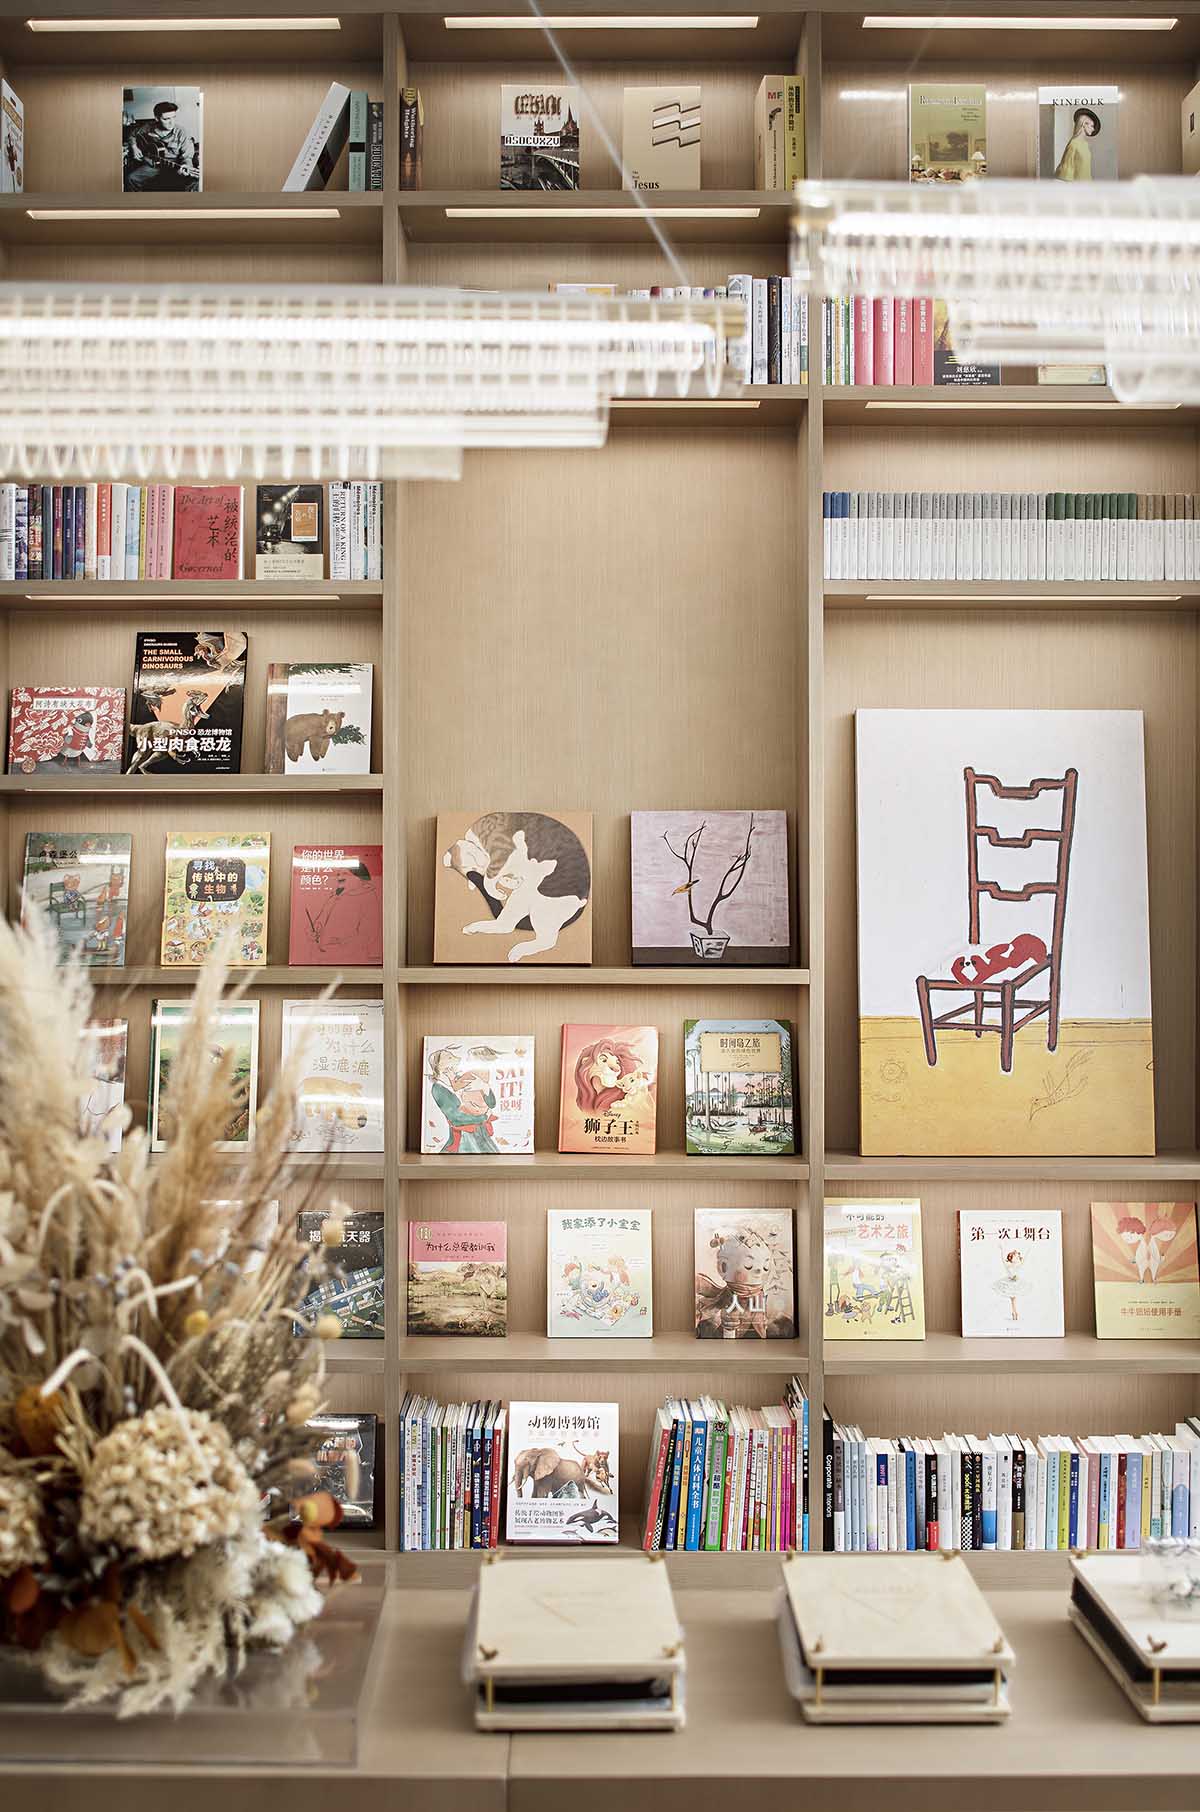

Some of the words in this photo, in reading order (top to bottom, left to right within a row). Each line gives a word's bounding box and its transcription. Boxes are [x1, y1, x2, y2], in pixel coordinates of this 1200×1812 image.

[1052, 98, 1105, 106] KINFOLK
[633, 179, 660, 189] Jesus
[207, 515, 219, 547] 艺术
[224, 498, 238, 563] 被统治的
[179, 562, 224, 573] Governed
[136, 737, 231, 752] 小型肉食恐龙
[300, 849, 345, 859] 你的世界
[192, 860, 215, 870] 寻找
[191, 872, 238, 883] 传说中的
[300, 875, 329, 886] 颜色?
[203, 884, 227, 895] 生物
[312, 1056, 369, 1076] 湿漉漉
[500, 1081, 522, 1099] IT!
[603, 1110, 621, 1118] Disney
[584, 1118, 634, 1135] 狮子王
[561, 1217, 641, 1231] 我家添了小宝宝
[309, 1230, 371, 1243] 揭天器
[857, 1224, 909, 1239] 艺术之旅
[970, 1226, 1050, 1241] 第一次上舞台
[425, 1241, 496, 1252] 为什么总爱教训我
[528, 1415, 600, 1430] 动物博物馆
[692, 1437, 703, 1509] 儿童人体百科全书
[825, 1454, 833, 1489] Corporate
